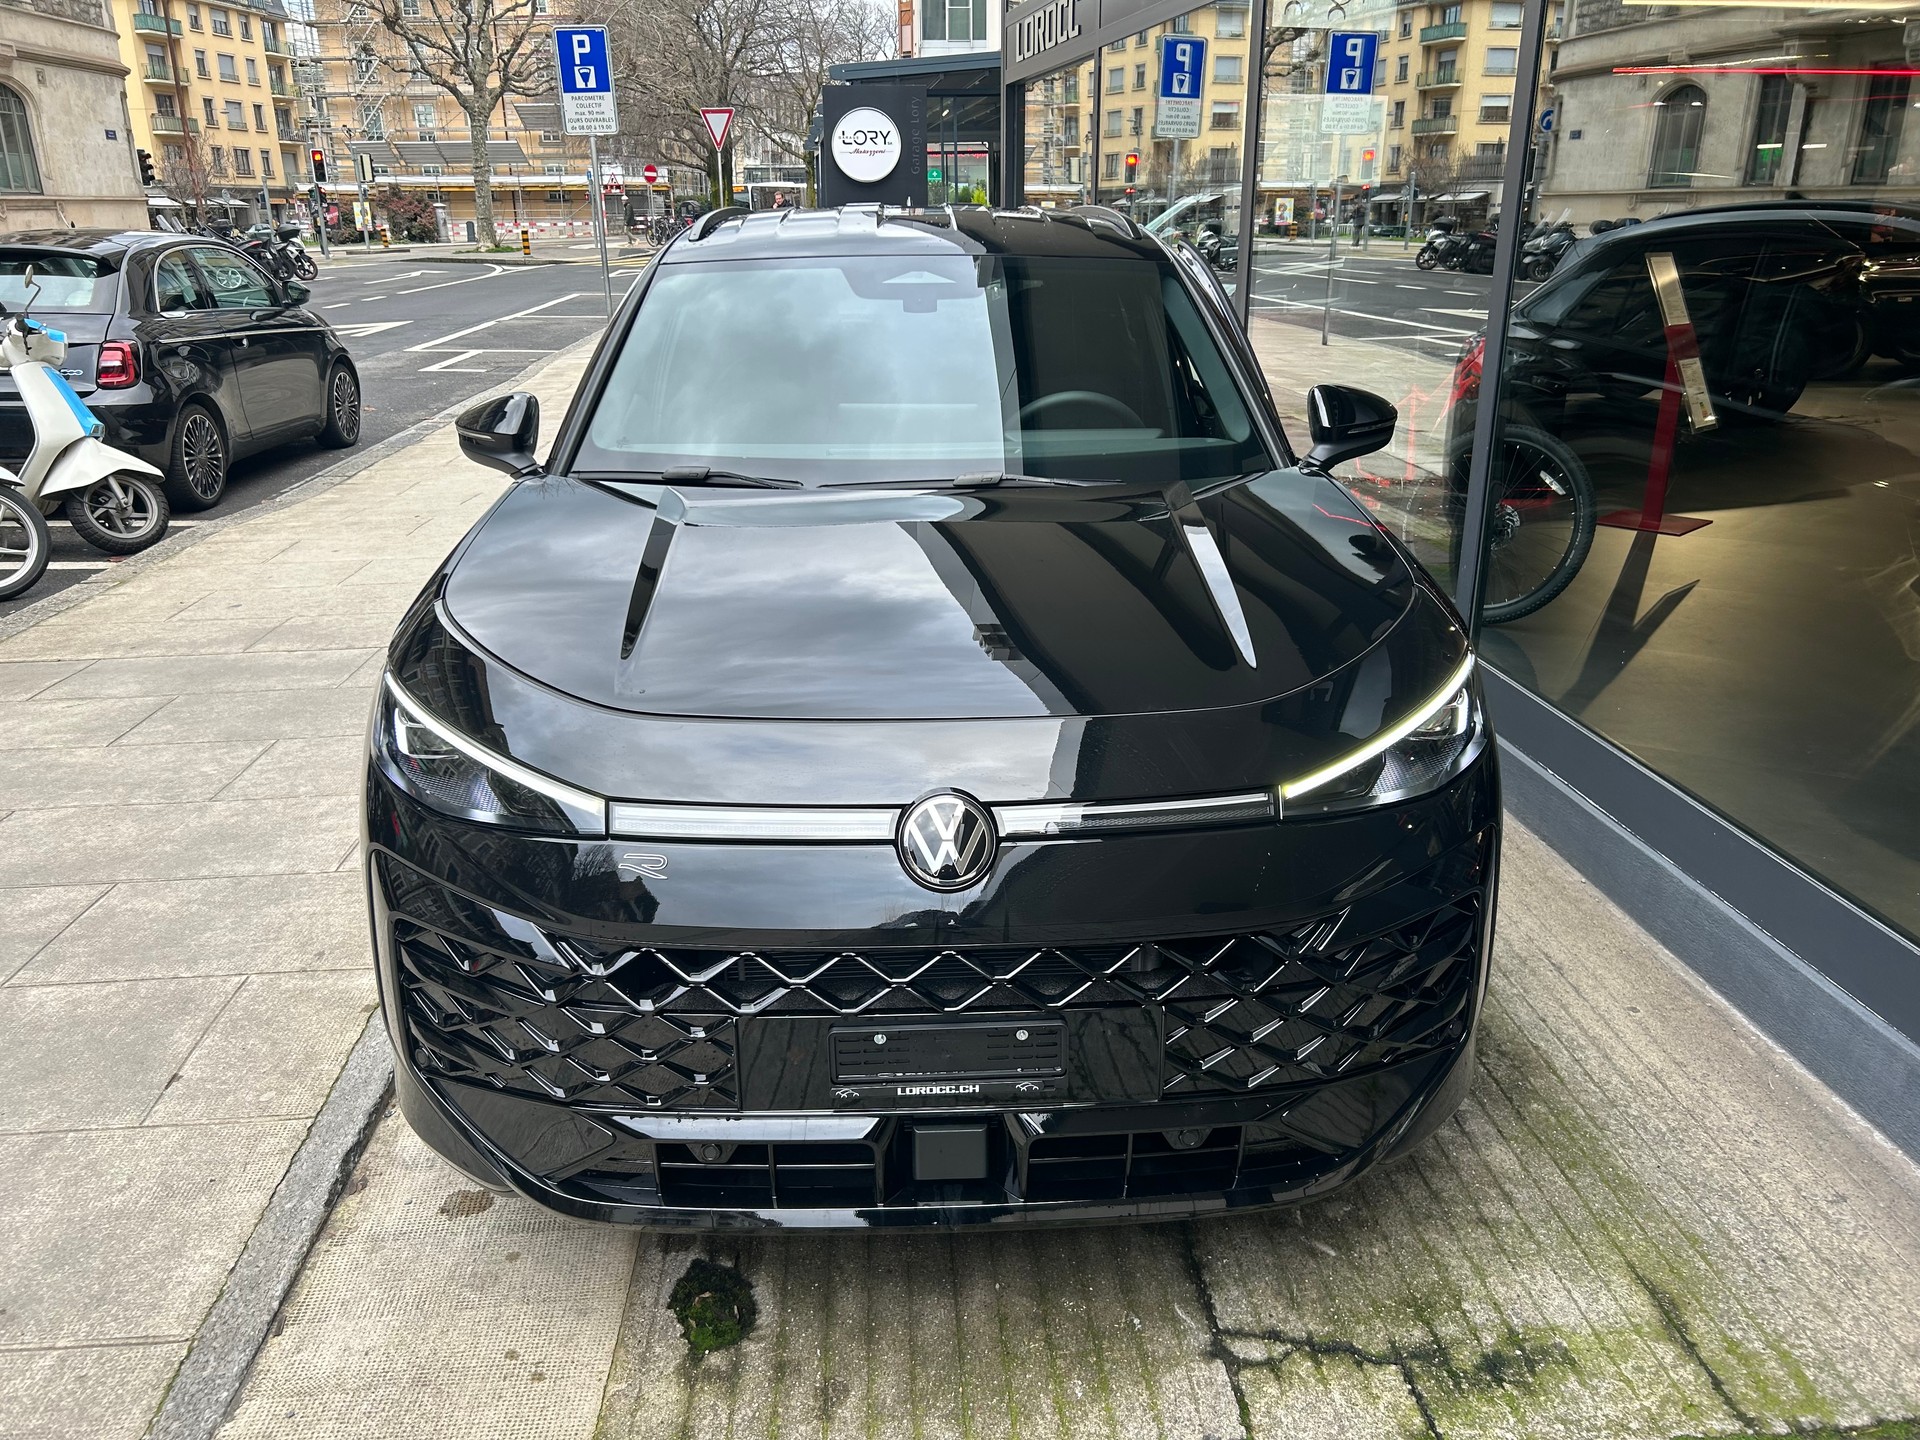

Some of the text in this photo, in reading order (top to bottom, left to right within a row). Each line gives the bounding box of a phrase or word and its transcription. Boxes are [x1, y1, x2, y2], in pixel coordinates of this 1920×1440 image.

[1016, 0, 1079, 63] LOROCC
[572, 34, 591, 65] P
[842, 129, 892, 146] LORY
[911, 97, 922, 175] Garage Lory
[897, 1084, 980, 1096] LOROCC.CH
